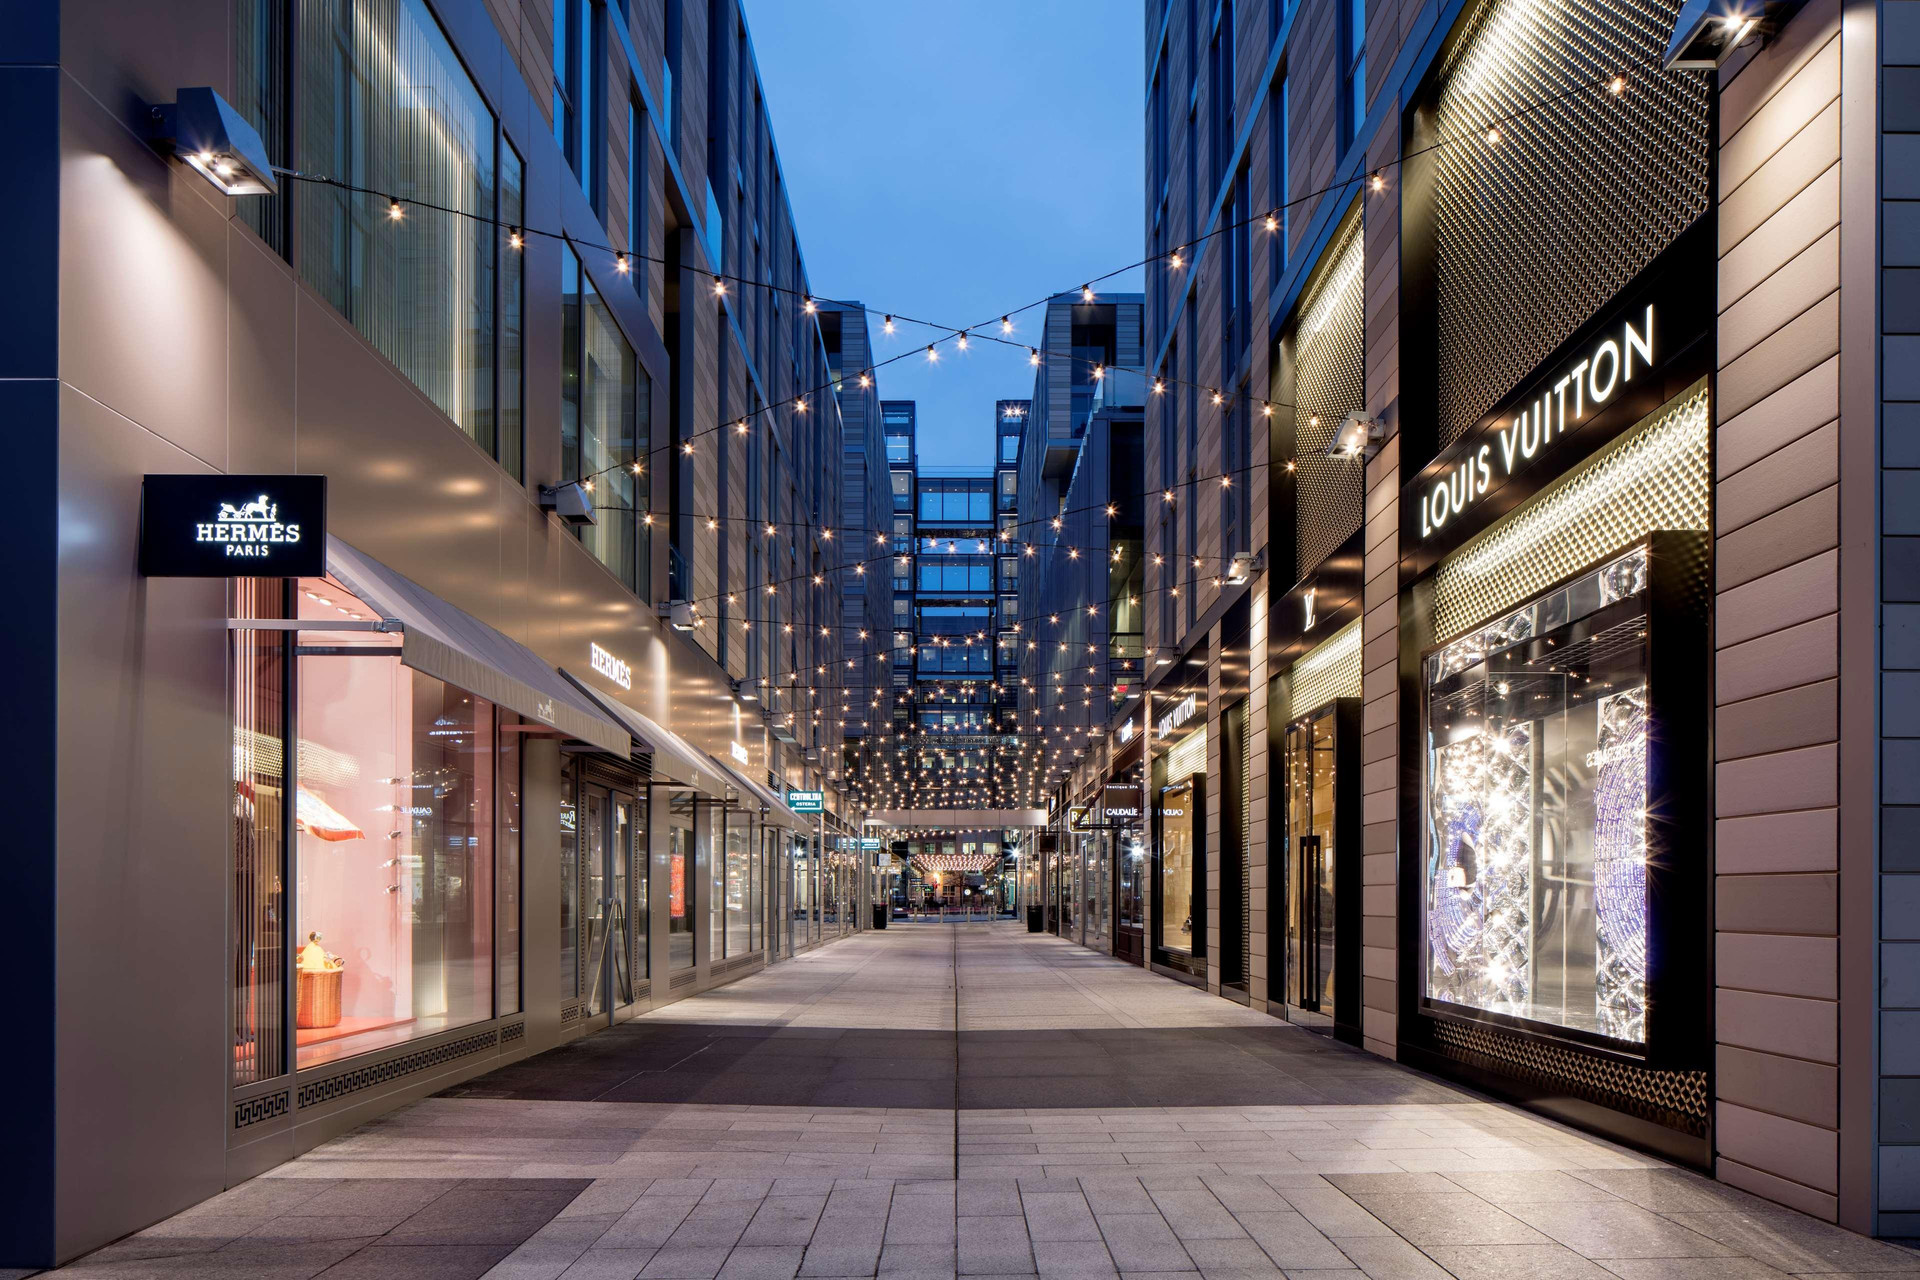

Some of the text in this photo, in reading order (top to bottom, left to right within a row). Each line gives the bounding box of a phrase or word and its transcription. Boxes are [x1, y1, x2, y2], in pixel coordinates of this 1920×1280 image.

[1422, 303, 1653, 538] LOUIS VUITTON
[196, 522, 300, 542] HERMÈS
[226, 545, 269, 556] PARIS
[1173, 692, 1196, 728] VUITTON
